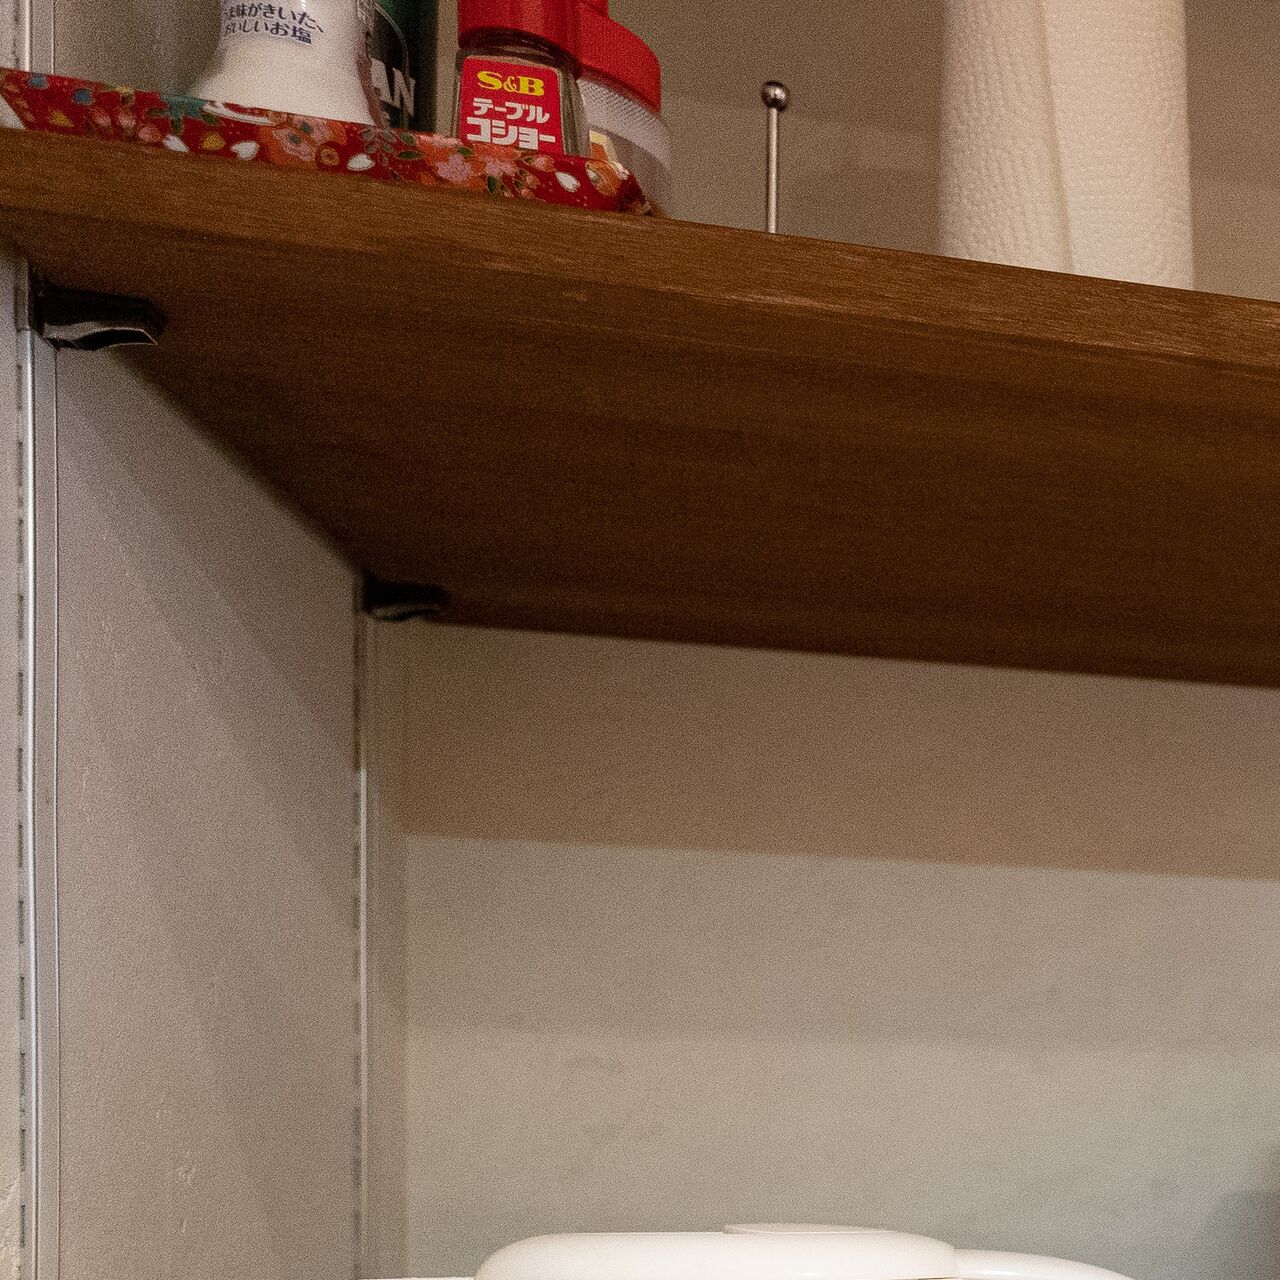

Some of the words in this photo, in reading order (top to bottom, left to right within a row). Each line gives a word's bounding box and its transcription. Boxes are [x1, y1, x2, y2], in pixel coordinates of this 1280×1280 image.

[477, 70, 545, 97] S&B
[472, 97, 550, 124] テーブル
[466, 116, 556, 150] コショー
